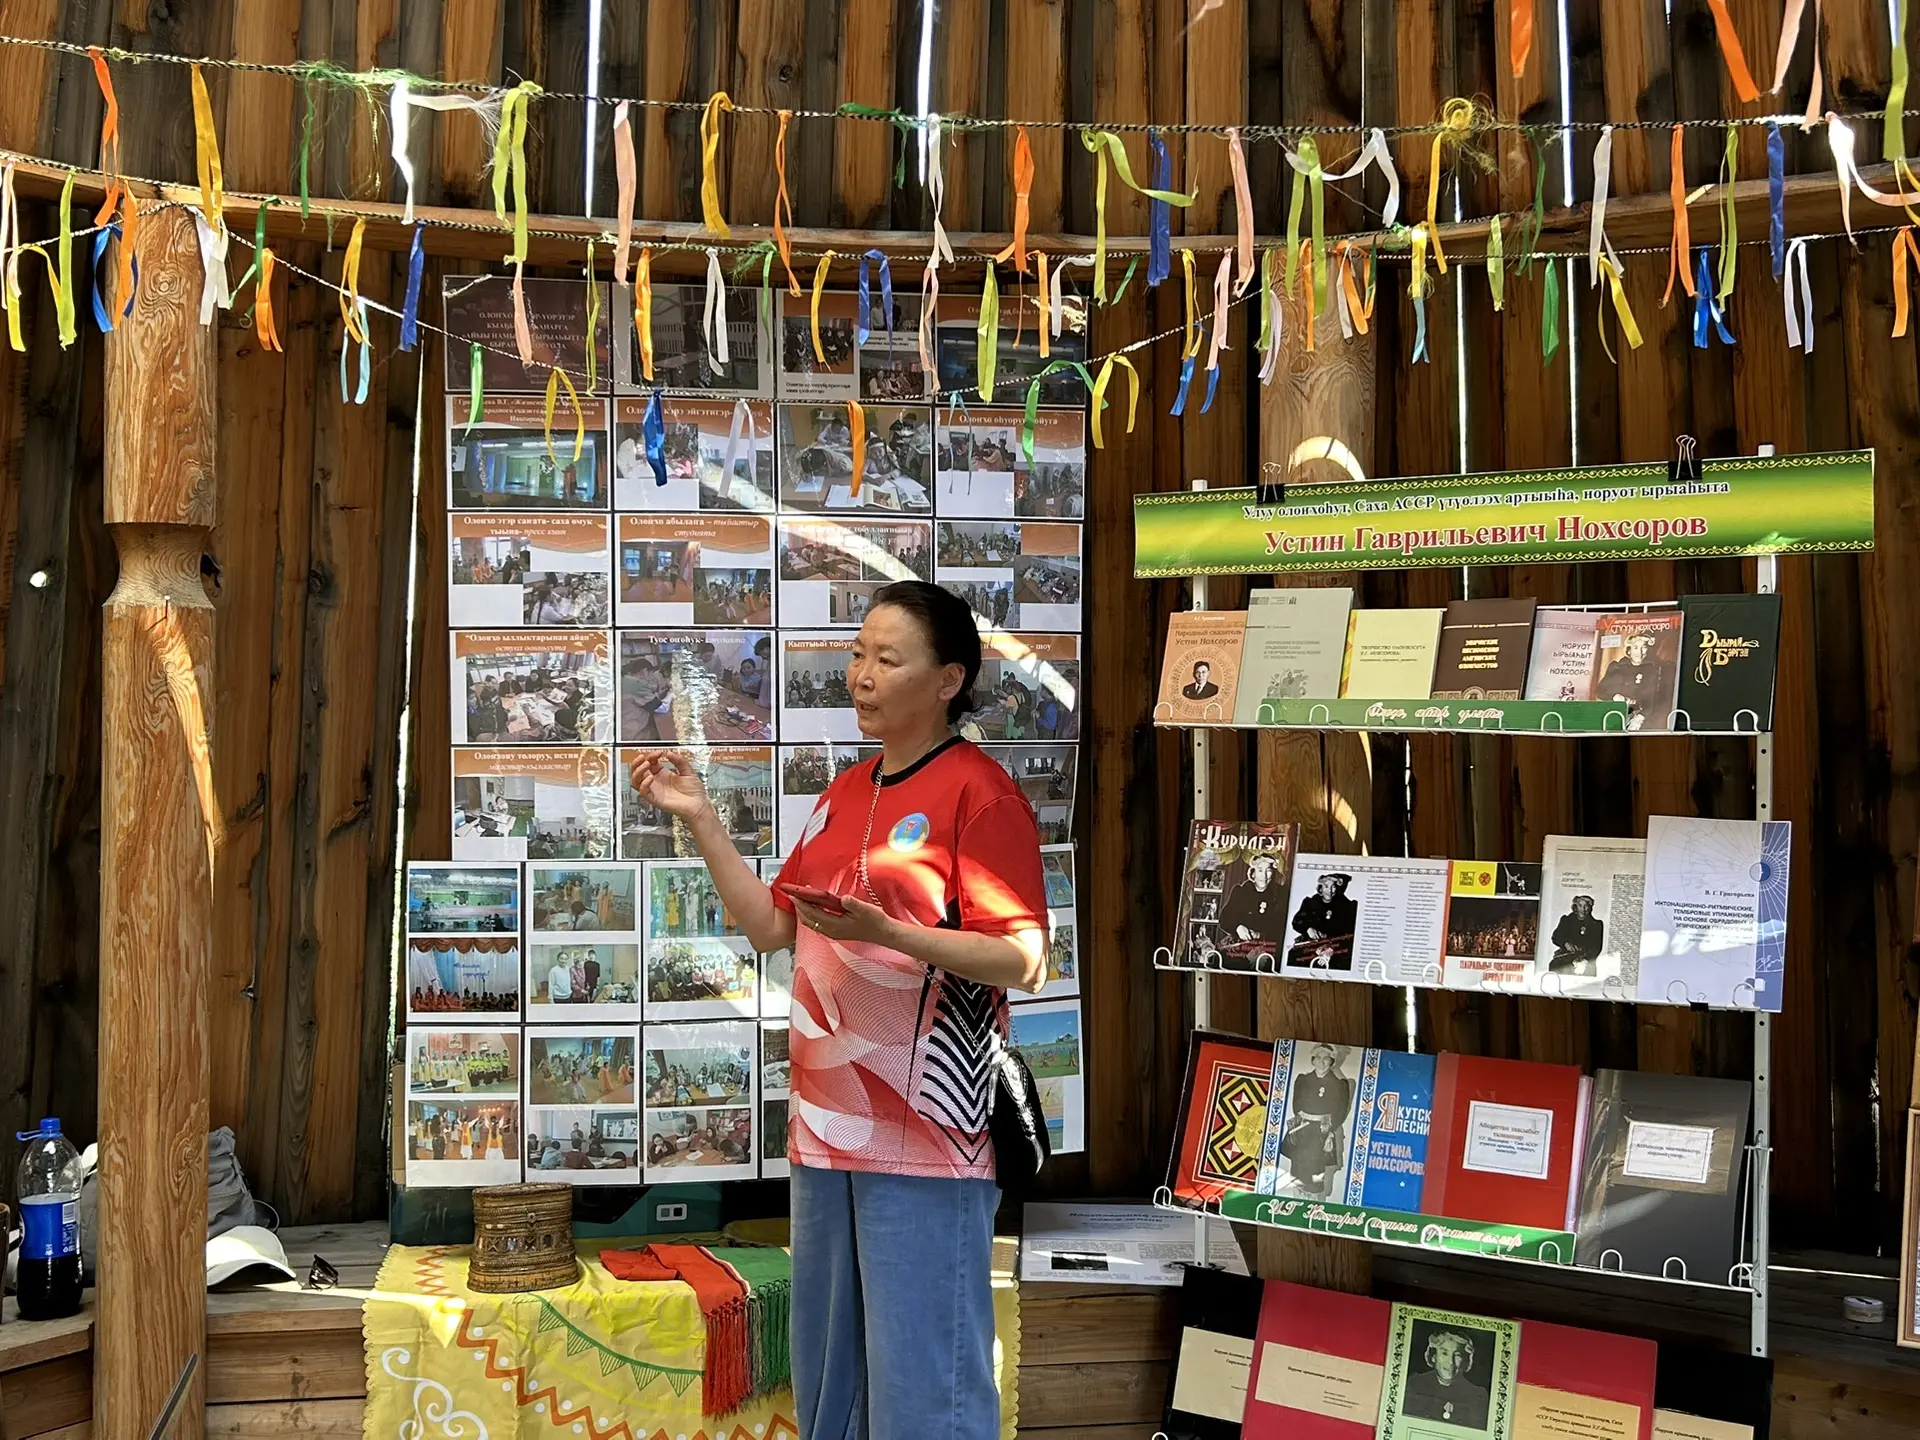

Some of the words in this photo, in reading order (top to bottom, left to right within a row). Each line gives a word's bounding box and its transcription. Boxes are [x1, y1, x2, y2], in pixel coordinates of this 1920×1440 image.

[1243, 506, 1275, 520] Улуу
[1355, 501, 1388, 512] Саха
[1391, 498, 1436, 511] АССР
[1583, 488, 1636, 503] норуот
[1264, 531, 1345, 555] Устин
[1354, 523, 1547, 555] Гаврильевич
[1556, 516, 1708, 545] Нохсоров
[1553, 651, 1592, 659] ЫРЫАҺЫТ
[1550, 667, 1590, 676] НОХСООРО
[1373, 1091, 1432, 1133] ЯКУТСК
[1396, 1120, 1431, 1136] ПЕСНИ
[1371, 1141, 1413, 1160] УСТИНА
